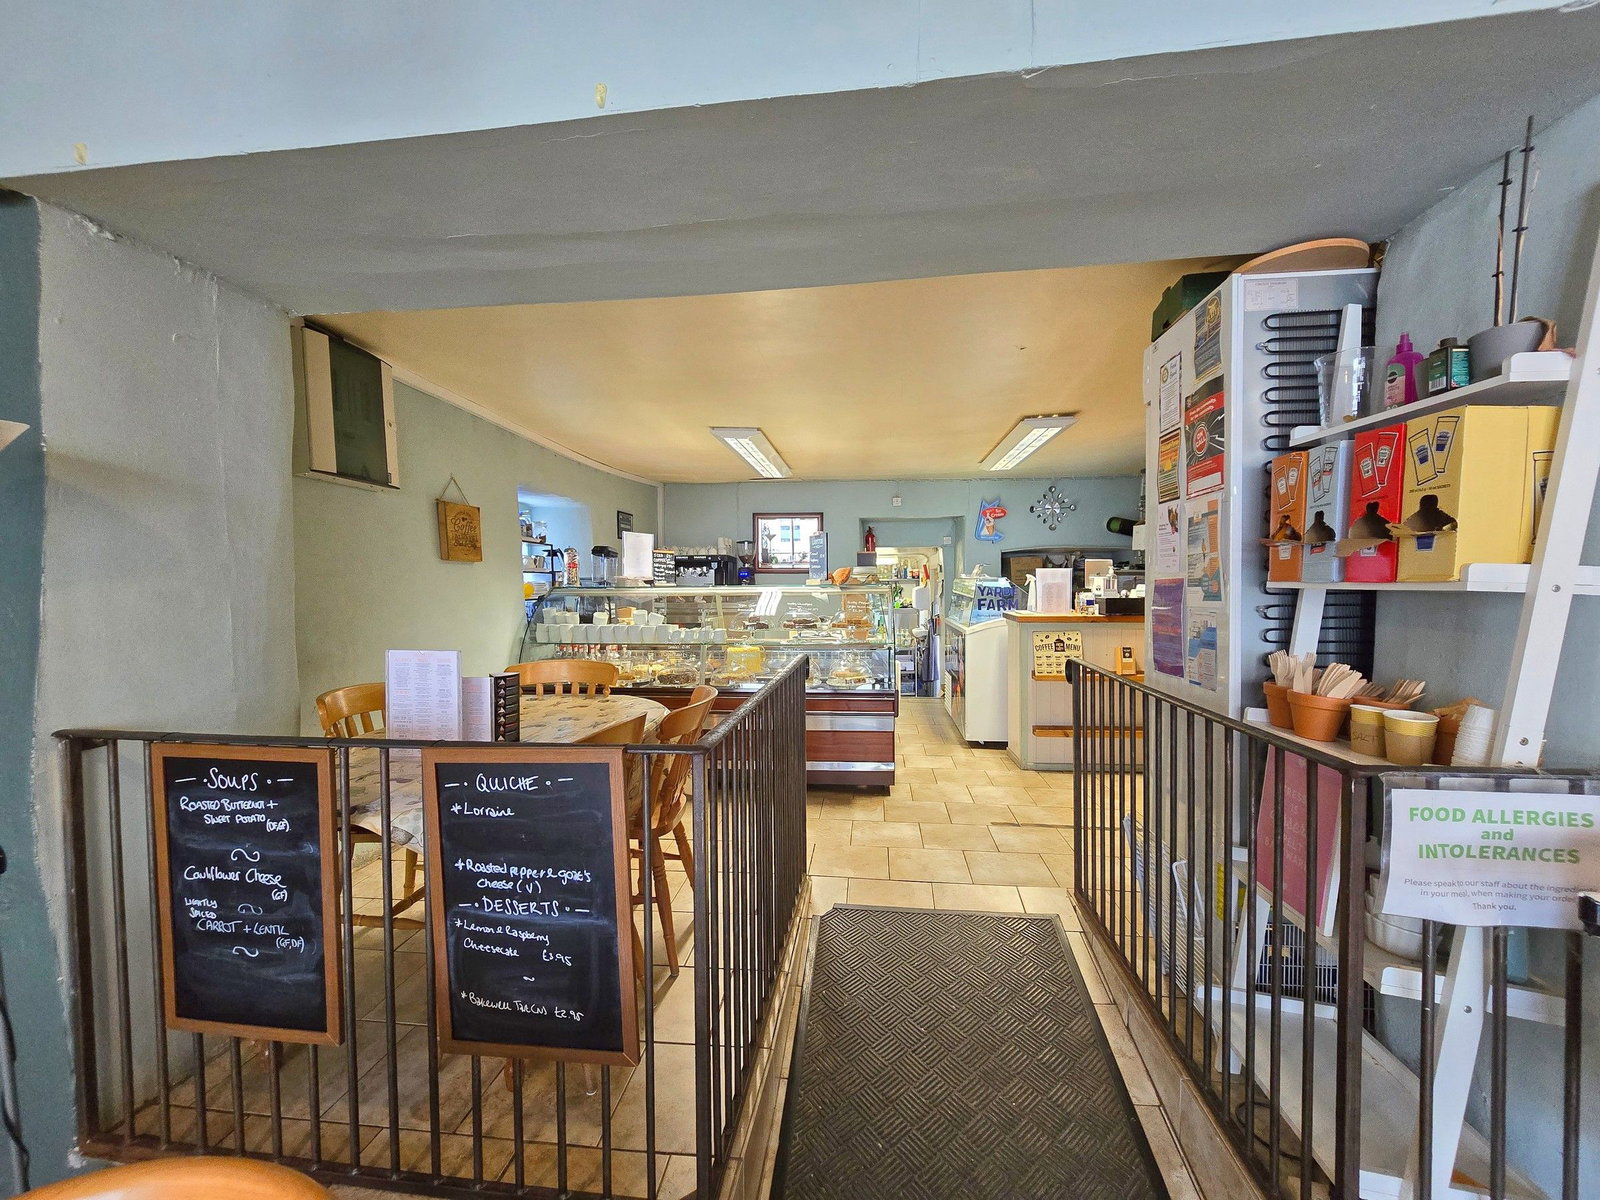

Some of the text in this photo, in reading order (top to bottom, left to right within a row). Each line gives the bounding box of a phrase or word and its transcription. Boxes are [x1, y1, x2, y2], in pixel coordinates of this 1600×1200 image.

[1196, 437, 1206, 448] CALL
[977, 598, 1019, 611] FARM
[1034, 643, 1081, 652] COFFEE MENU
[475, 772, 539, 793] QUICHE
[180, 796, 278, 812] ROASTED BUTTERNUT +
[464, 801, 515, 817] Lorraine
[203, 814, 231, 825] SWEET
[235, 813, 266, 825] POTATO
[1409, 806, 1595, 829] FOOD ALLERGIES
[1480, 828, 1514, 841] and
[1417, 843, 1581, 864] INTOLERANCES
[184, 865, 287, 888] Cauliflower Cheese
[1404, 878, 1432, 887] Please
[1433, 879, 1457, 888] speak
[1480, 880, 1500, 888] staff
[1501, 881, 1528, 890] about
[1529, 883, 1544, 891] the
[271, 889, 288, 902] (GF)
[1430, 890, 1449, 898] your
[1494, 890, 1527, 901] making
[1527, 893, 1550, 901] your
[185, 897, 218, 909] LIGHTLY
[481, 895, 559, 917] DESSERTS
[1472, 902, 1517, 912] Thank you.
[196, 918, 290, 936] CARROT + LENTIL
[463, 937, 573, 966] Cheesecake £3.95
[554, 1006, 585, 1022] £2.95
